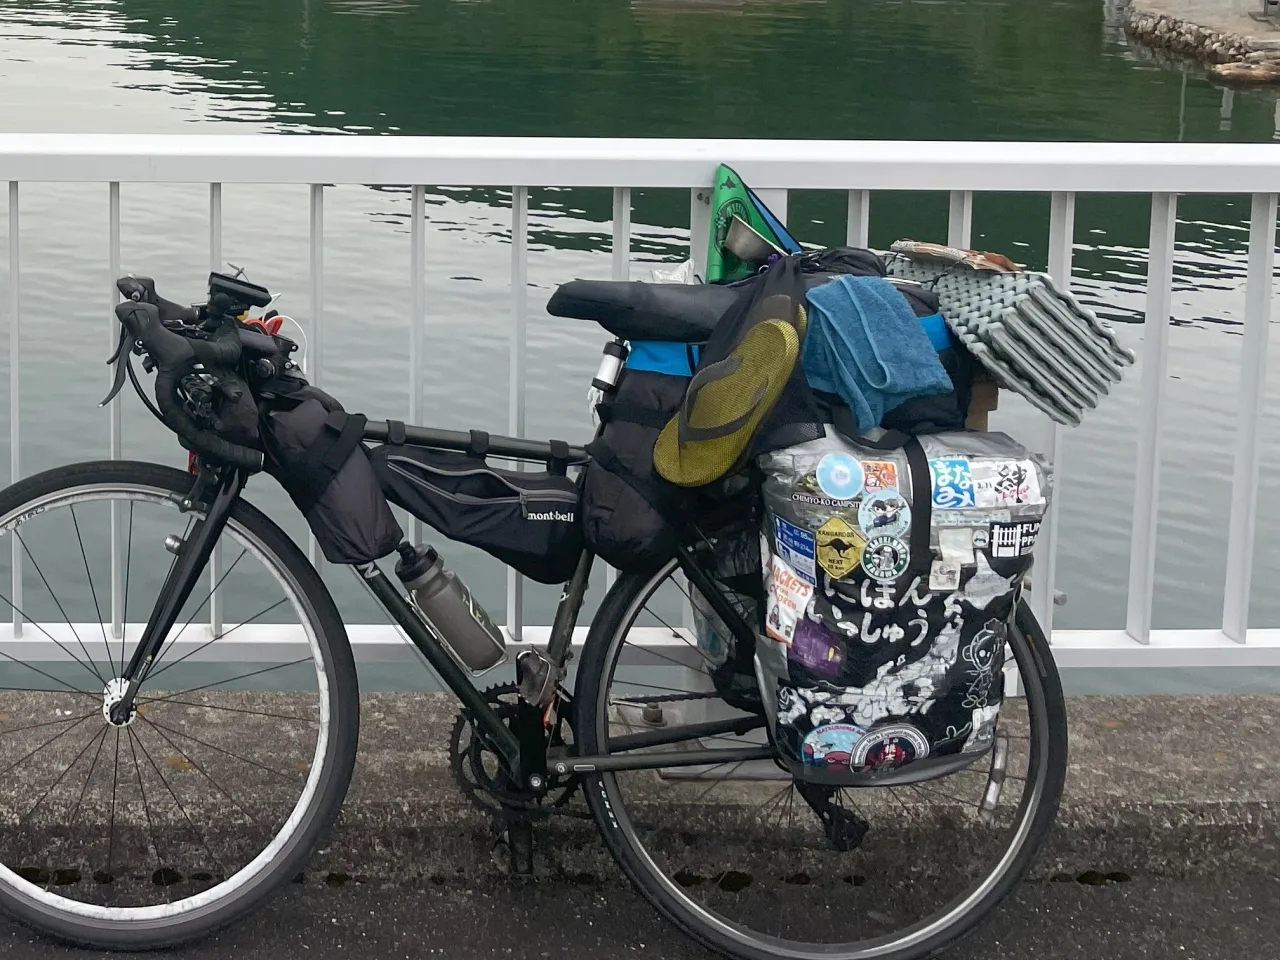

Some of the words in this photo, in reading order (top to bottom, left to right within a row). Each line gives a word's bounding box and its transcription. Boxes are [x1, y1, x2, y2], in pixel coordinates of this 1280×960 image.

[831, 500, 860, 509] CAMPSIT
[828, 557, 843, 565] NEXT
[824, 574, 932, 609] にほん
